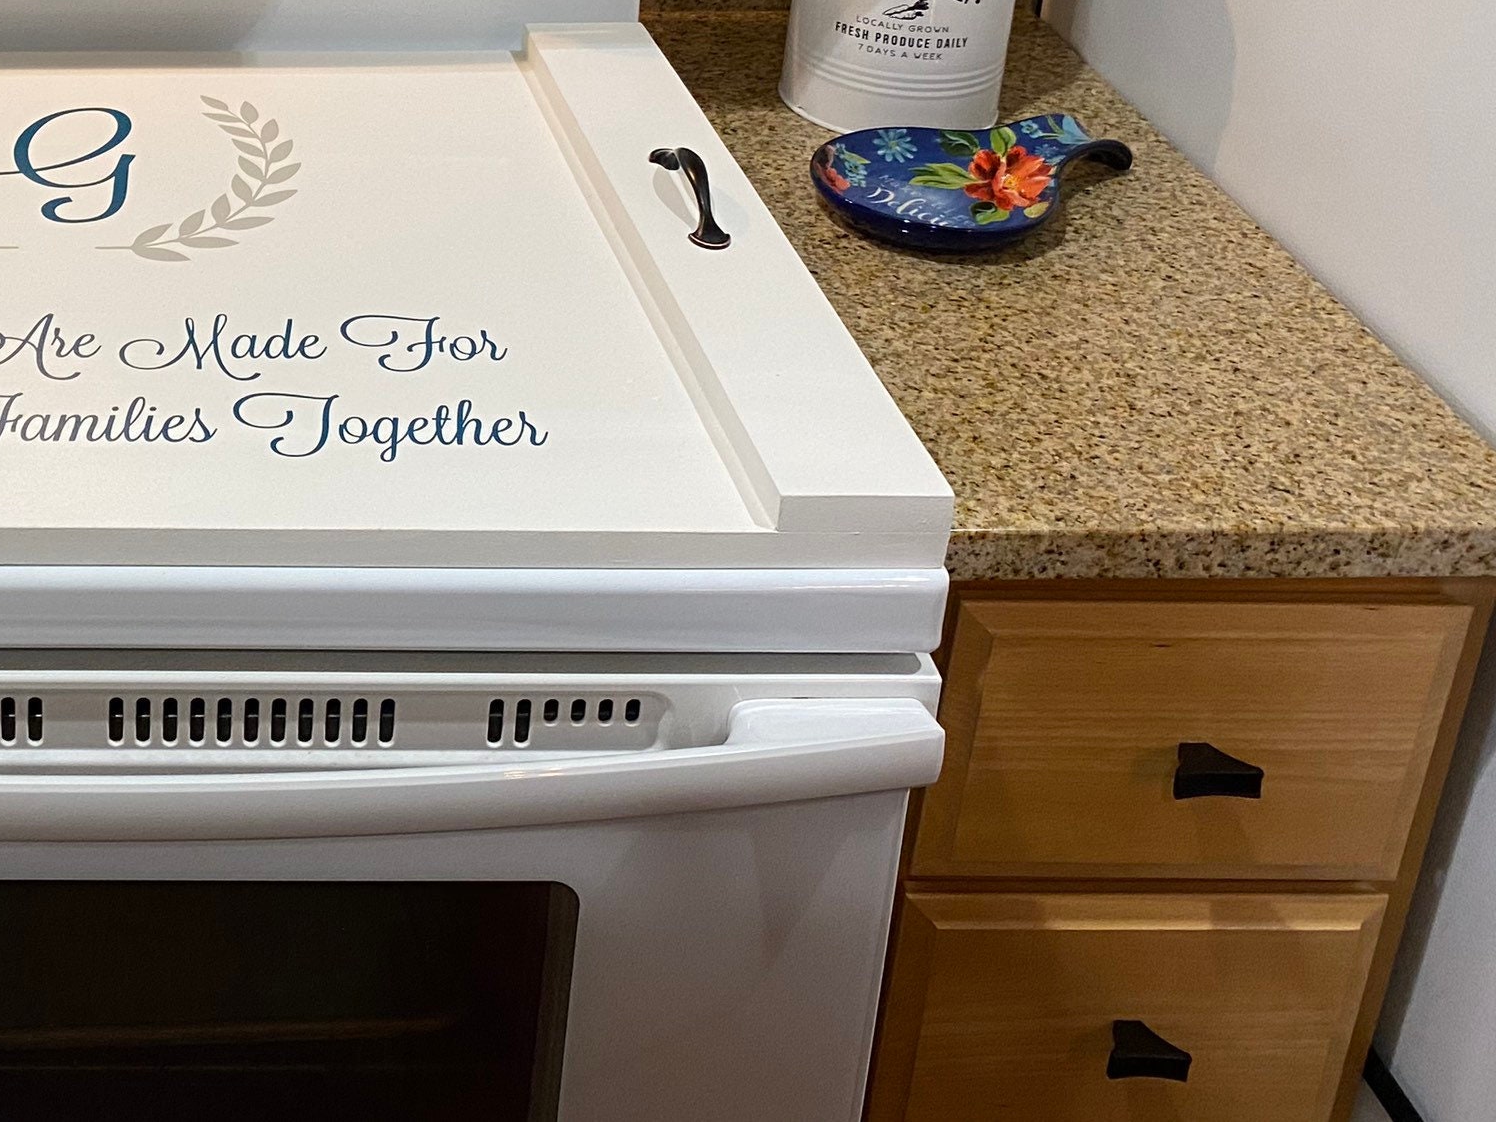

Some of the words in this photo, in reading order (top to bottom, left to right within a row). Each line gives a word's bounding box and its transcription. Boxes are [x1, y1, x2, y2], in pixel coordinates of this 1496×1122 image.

[835, 21, 870, 40] FRESH
[875, 32, 931, 49] PRODUCE
[936, 37, 968, 49] DAILY
[856, 15, 904, 31] LOCALLY
[908, 24, 950, 34] GROWN
[866, 45, 896, 57] DAYS
[118, 313, 328, 381] Made
[339, 314, 508, 373] For
[232, 392, 549, 463] Together
